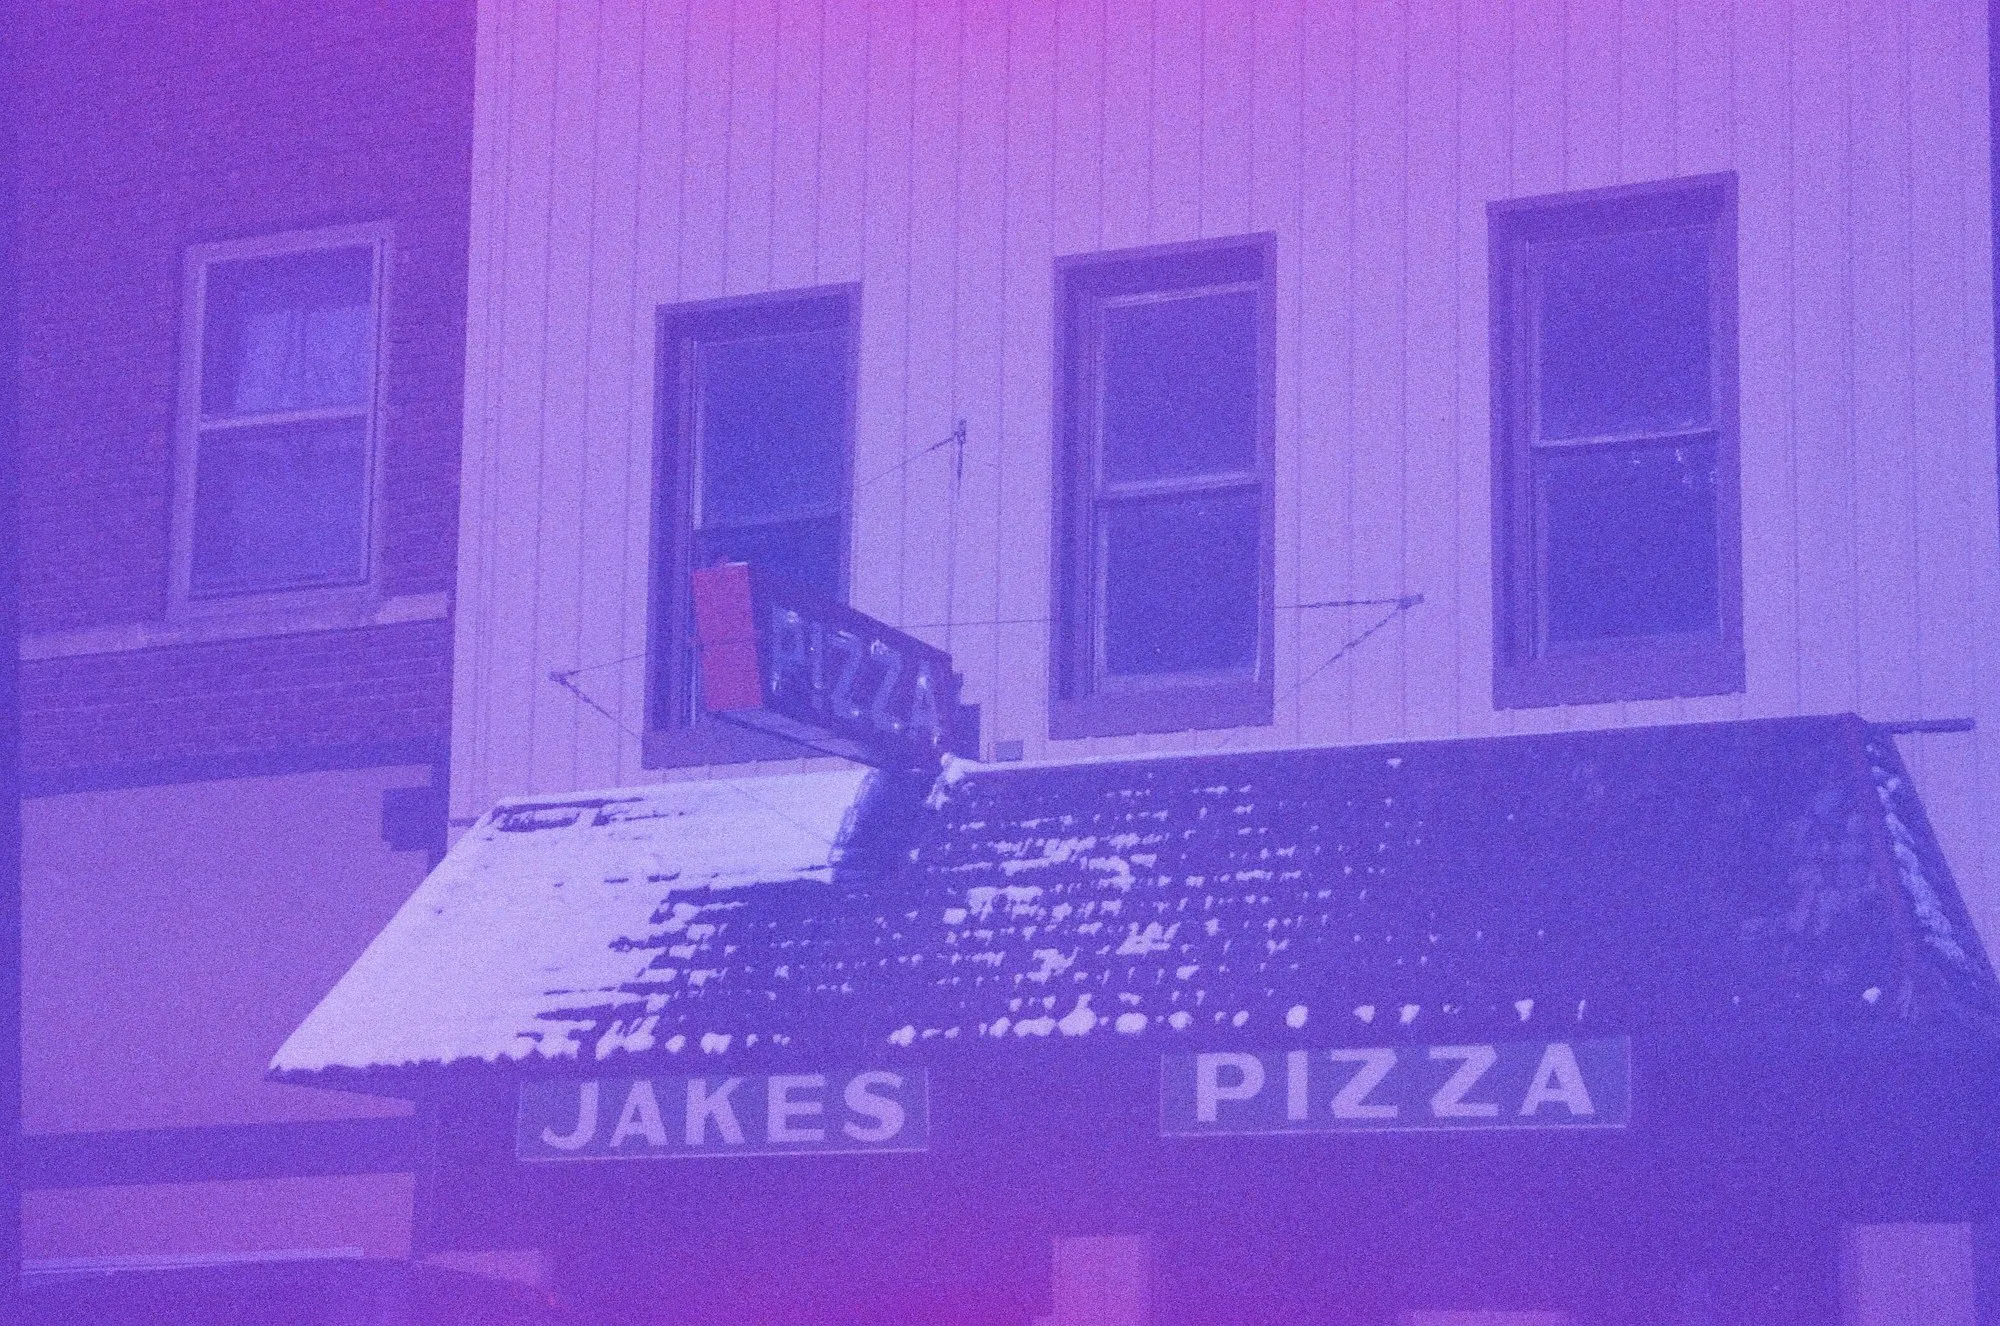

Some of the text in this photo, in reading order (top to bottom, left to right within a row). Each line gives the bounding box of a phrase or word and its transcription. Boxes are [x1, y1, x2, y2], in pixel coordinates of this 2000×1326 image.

[770, 605, 942, 747] PIZZA
[541, 1070, 906, 1150] JAKES
[1197, 1043, 1595, 1122] PIZZA
